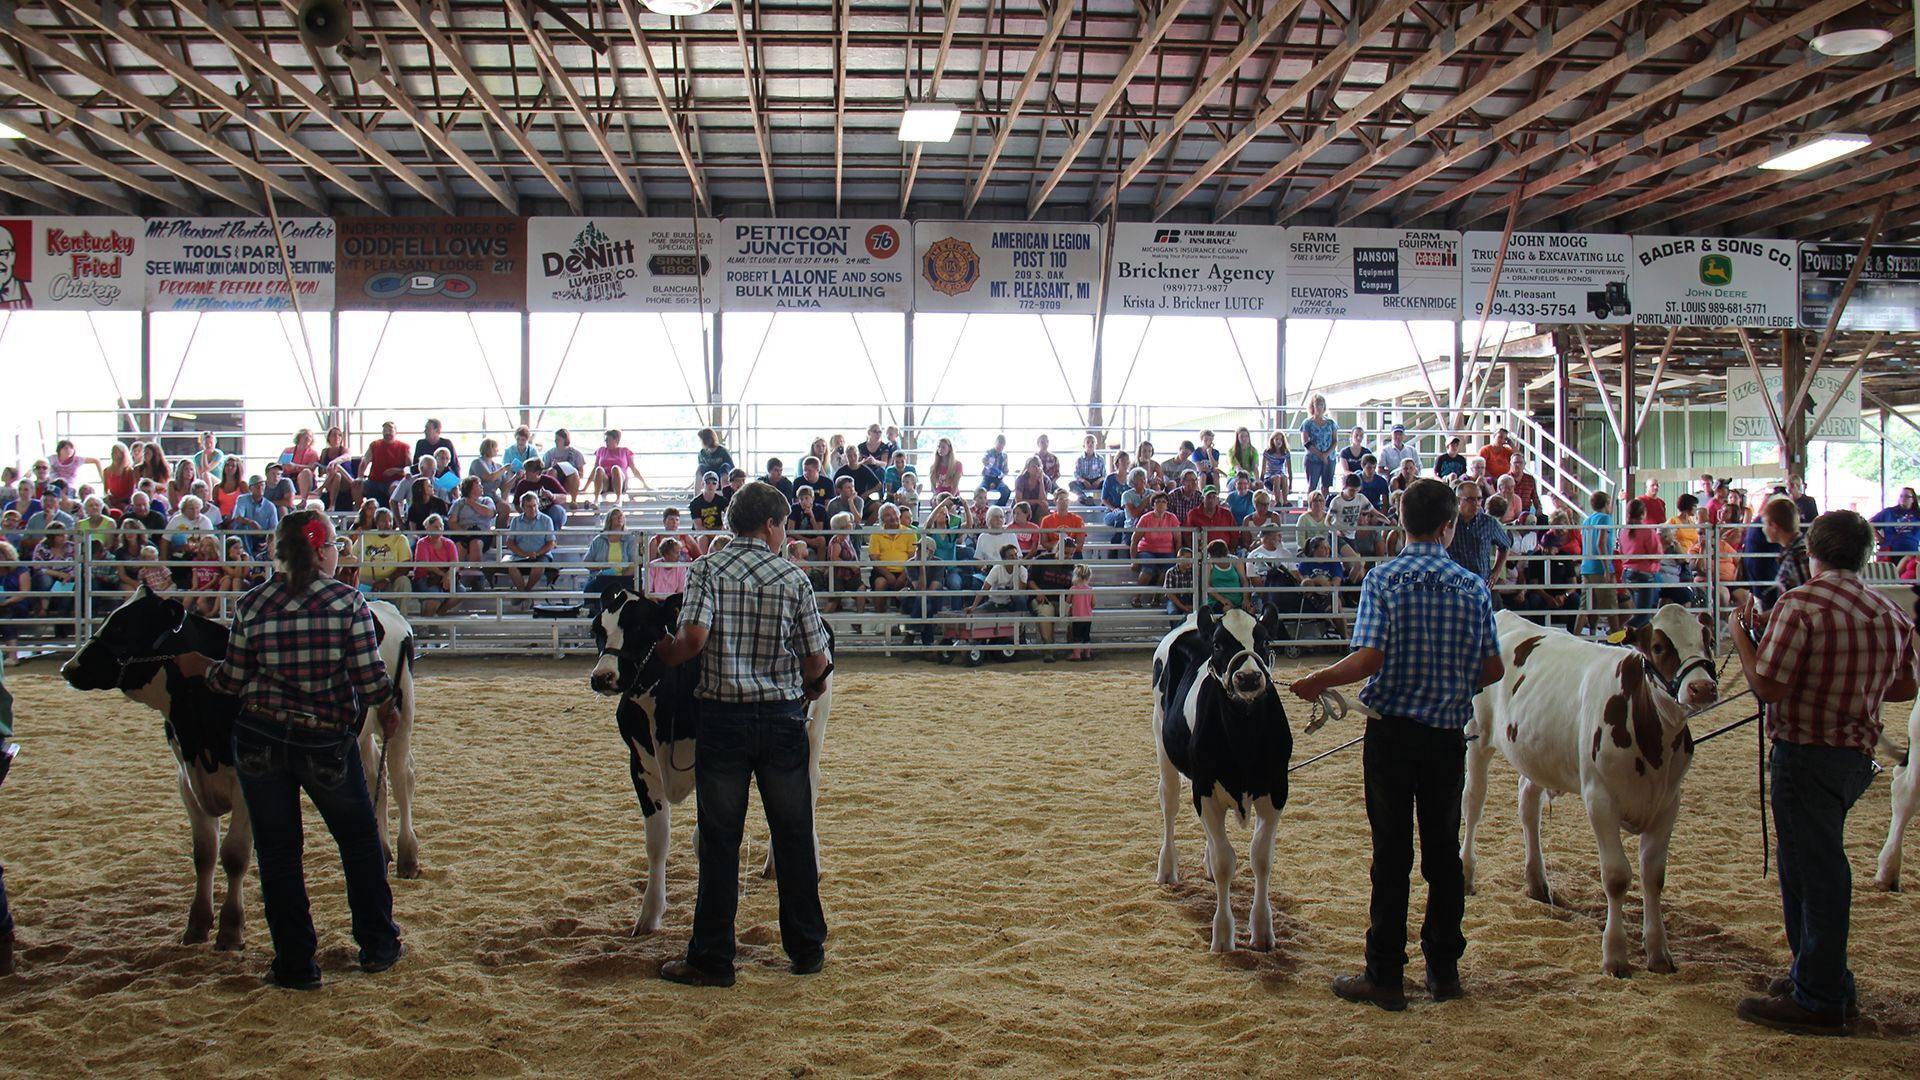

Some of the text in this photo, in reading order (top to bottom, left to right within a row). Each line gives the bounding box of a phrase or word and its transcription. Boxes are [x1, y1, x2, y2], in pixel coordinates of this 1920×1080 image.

[167, 220, 232, 239] Pleasant
[281, 221, 334, 239] Center
[341, 223, 517, 234] INDEPENDENT ORDER OF
[736, 226, 851, 240] PETTICOAT
[47, 229, 135, 255] Kentucky
[872, 233, 893, 250] 76
[992, 232, 1090, 249] AMERICAN LEGION
[1303, 232, 1336, 242] FARM
[1510, 235, 1587, 247] JOHN MOGG
[344, 237, 509, 256] ODDFELLOWS
[738, 242, 847, 255] JUNCTION
[1290, 243, 1340, 253] SERVICE
[1399, 240, 1457, 249] EQUIPMENT
[183, 246, 231, 258] TOOLS
[542, 239, 635, 277] DeWitt
[1357, 252, 1395, 262] JANSON
[1528, 252, 1536, 260] &
[1539, 251, 1603, 262] EXCAVATING
[1606, 253, 1624, 262] LLC
[1639, 239, 1792, 271] BADER & SONS CO.
[364, 260, 433, 271] PLEASANT
[440, 260, 483, 270] LODGE
[1014, 252, 1067, 267] POST 110
[1846, 254, 1872, 270] PE
[1876, 255, 1884, 271] &
[71, 254, 121, 279] Fried
[146, 261, 171, 275] SEE
[173, 262, 204, 274] WHAT
[206, 262, 226, 274] YOU
[226, 262, 247, 274] CAN
[250, 262, 265, 274] DO
[270, 262, 283, 274] BY
[1359, 268, 1394, 277] Equipment
[569, 269, 638, 288] LUMBER CO.
[727, 270, 902, 284] ROBERT LALONE AND SONS
[1015, 271, 1064, 279] 209 S. OAK
[1118, 262, 1274, 285] Brickner Agency
[49, 273, 121, 306] Chicken
[158, 280, 320, 295] PROPANE REFILL STAON
[736, 286, 885, 298] BULK MILK HAULING
[990, 282, 1090, 300] MT. PLEASANT, MI
[1163, 284, 1185, 292] (989)
[1362, 281, 1392, 290] Company
[1292, 287, 1348, 298] ELEVATORS
[1496, 290, 1555, 299] Mt. Pleasant
[1686, 289, 1748, 298] JOHN DEERE
[776, 300, 821, 308] ALMA
[1019, 300, 1061, 309] 772-9709
[1123, 295, 1264, 310] Krista J. Brickner LUTCF
[1383, 296, 1457, 309] BRECKENRIDGE
[1666, 301, 1767, 314] ST. LOUIS 989-681-5771
[1476, 303, 1576, 316] 99-433-5754
[1637, 314, 1793, 327] PORTLAND LINWOOD GRAND LEDGE
